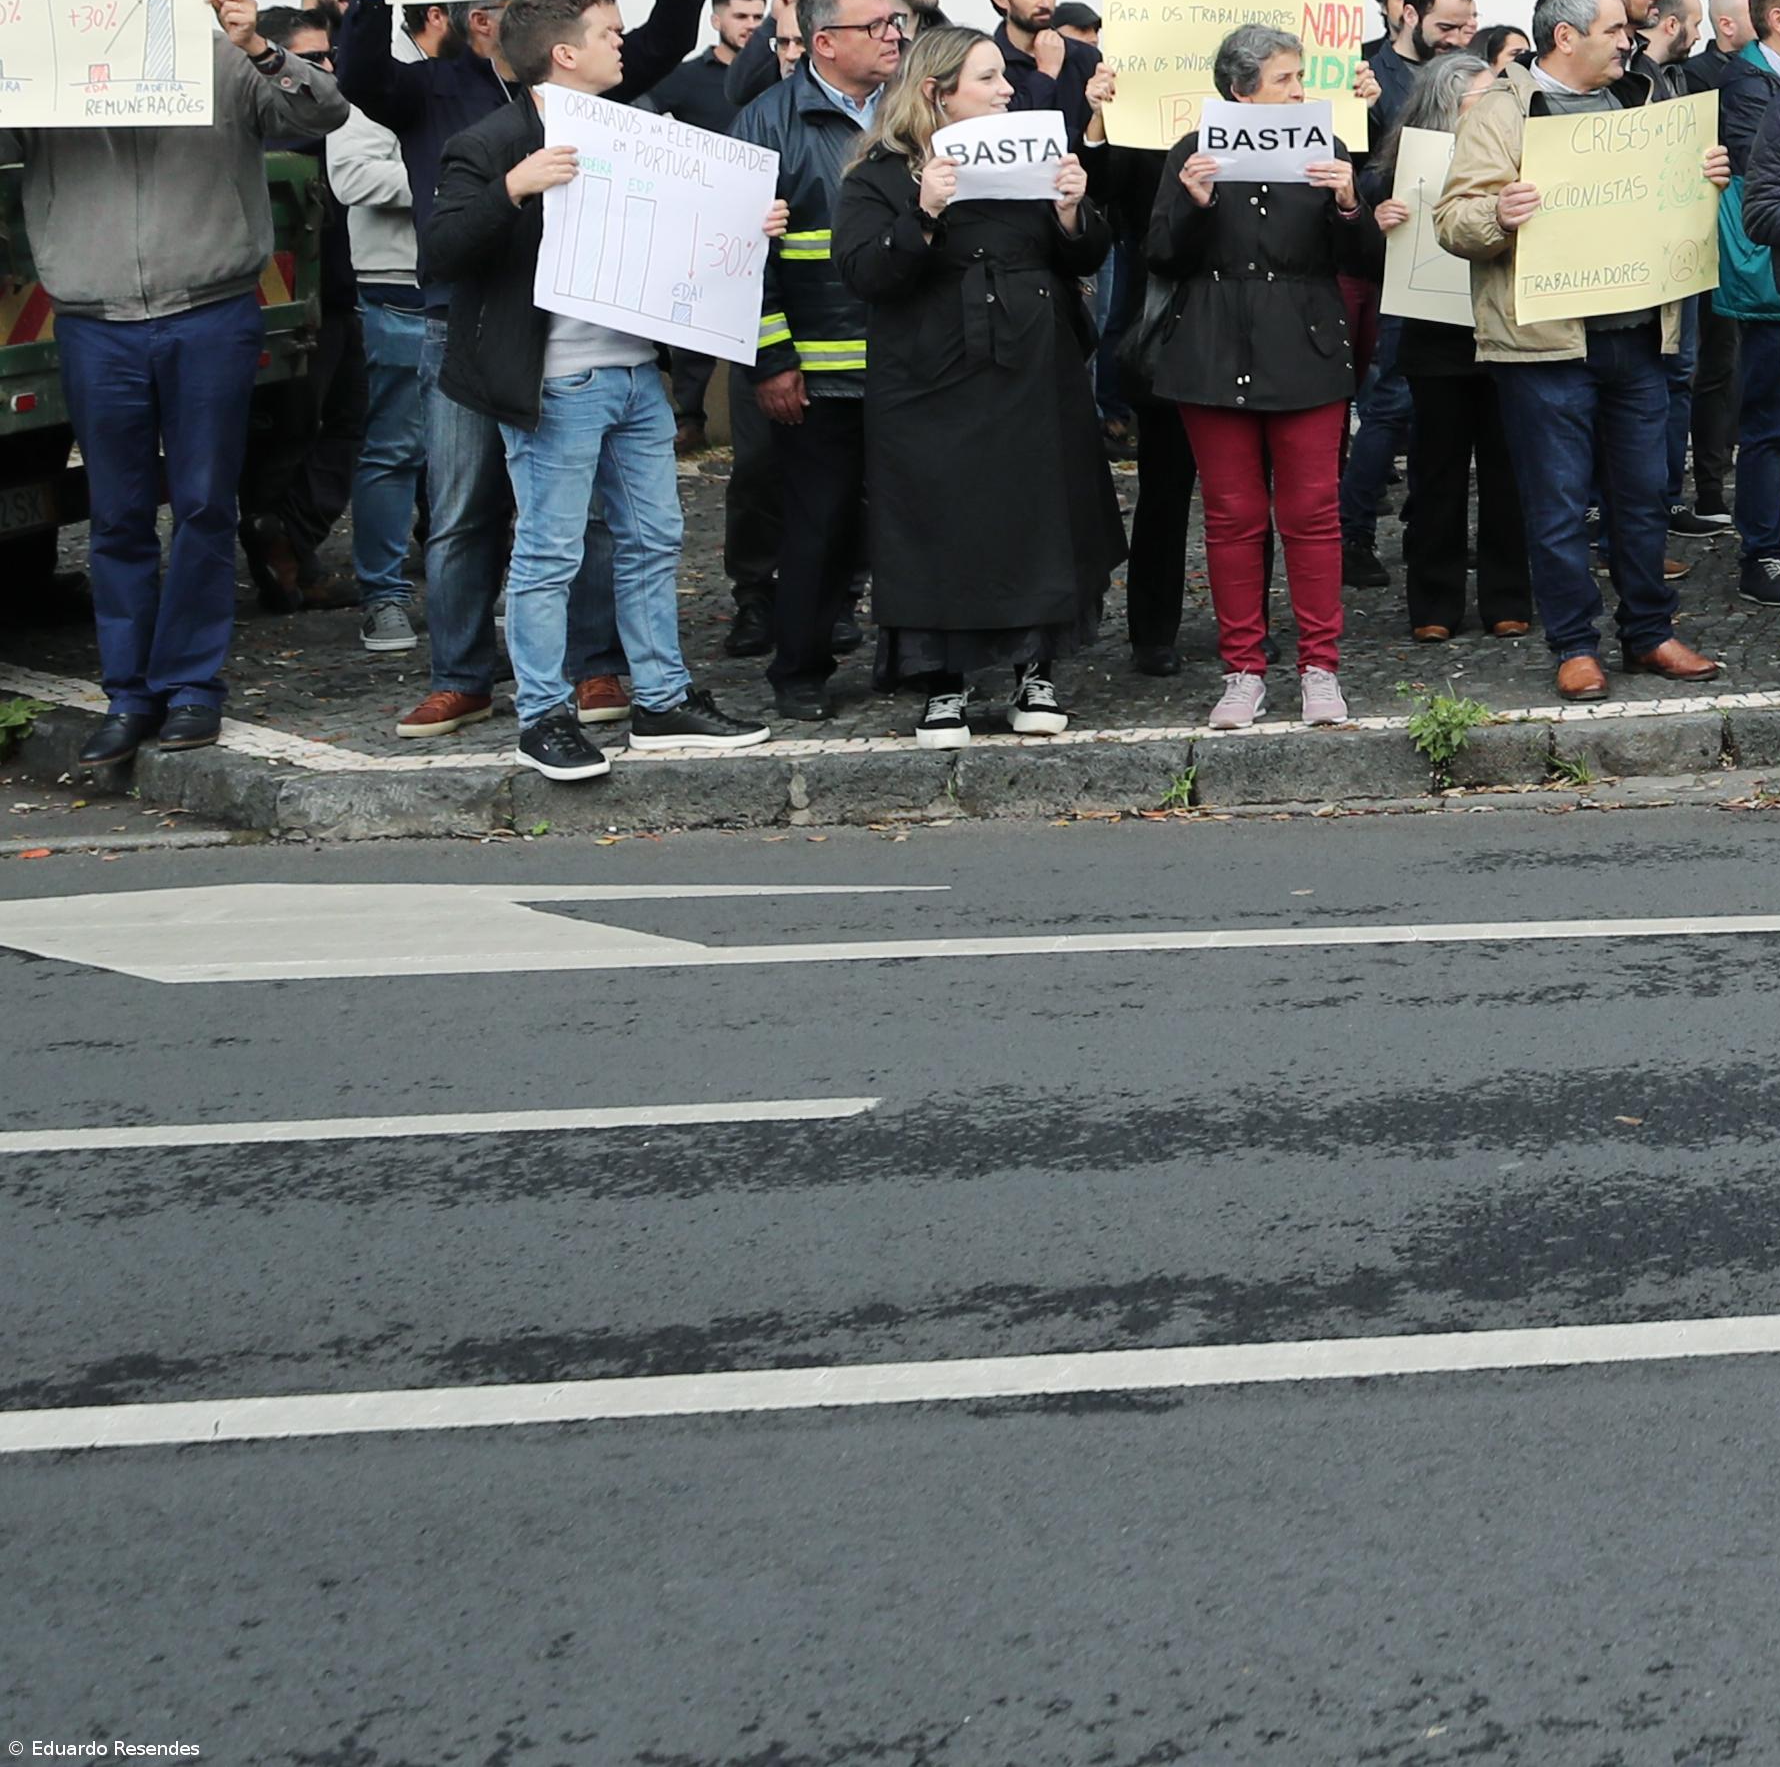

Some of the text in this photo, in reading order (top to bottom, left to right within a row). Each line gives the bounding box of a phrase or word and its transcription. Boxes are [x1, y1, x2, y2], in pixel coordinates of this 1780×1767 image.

[68, 0, 118, 34] +30%
[1109, 1, 1363, 51] PARA OS TRABALHADORES NADA
[85, 94, 205, 117] REMUNERAÇÕES
[135, 83, 184, 94] MADEIRA
[565, 93, 774, 173] ORDENADOS NA ELETRICIDADE
[1207, 126, 1328, 151] BASTA
[1572, 109, 1650, 154] CRISES
[1666, 102, 1697, 147] EDA
[613, 138, 714, 189] EM PORTUGAL
[945, 138, 1063, 166] BASTA
[1539, 175, 1649, 212] CCIONISTAS
[704, 232, 759, 278] -30%
[671, 281, 704, 302] EDA!
[1521, 261, 1650, 296] TRABALHADORES
